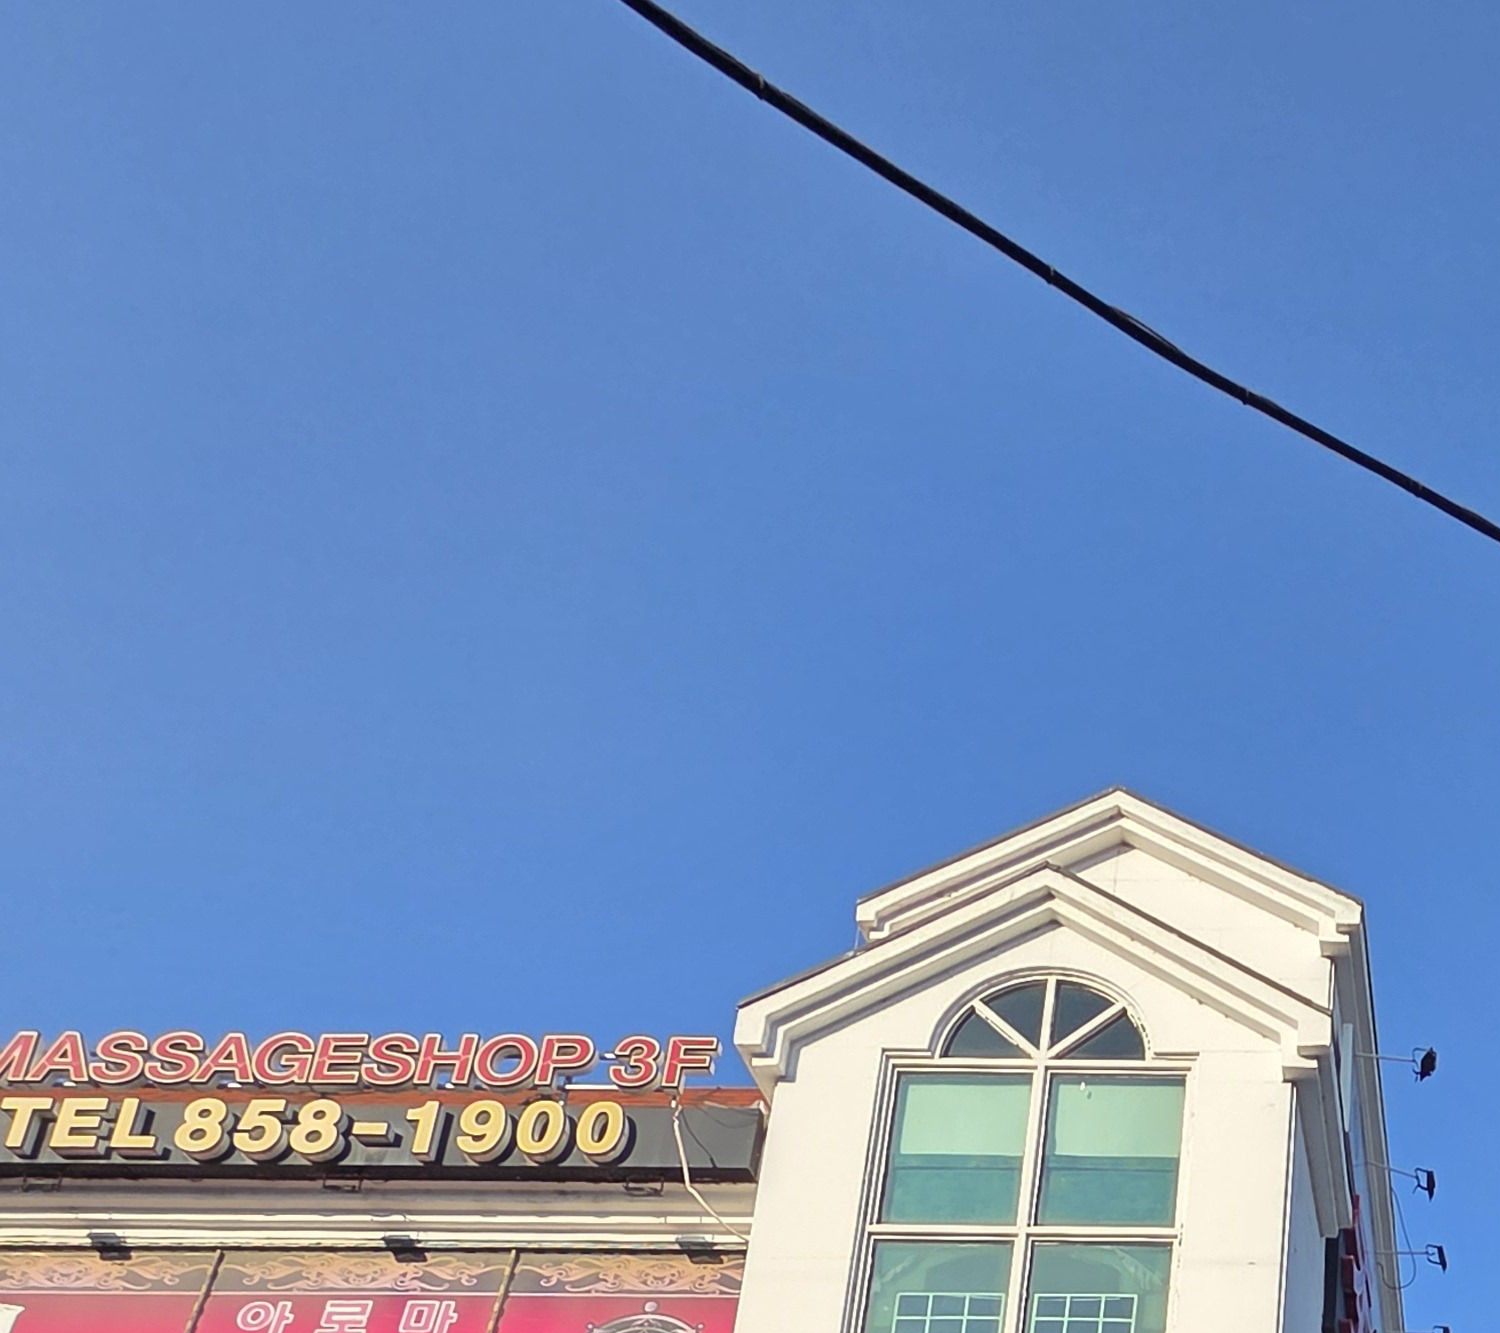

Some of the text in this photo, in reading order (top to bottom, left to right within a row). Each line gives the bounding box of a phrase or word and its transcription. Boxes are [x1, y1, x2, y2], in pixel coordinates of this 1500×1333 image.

[0, 1030, 719, 1087] MASSAGESHOP 3F
[0, 1097, 627, 1156] TEL 858-1900
